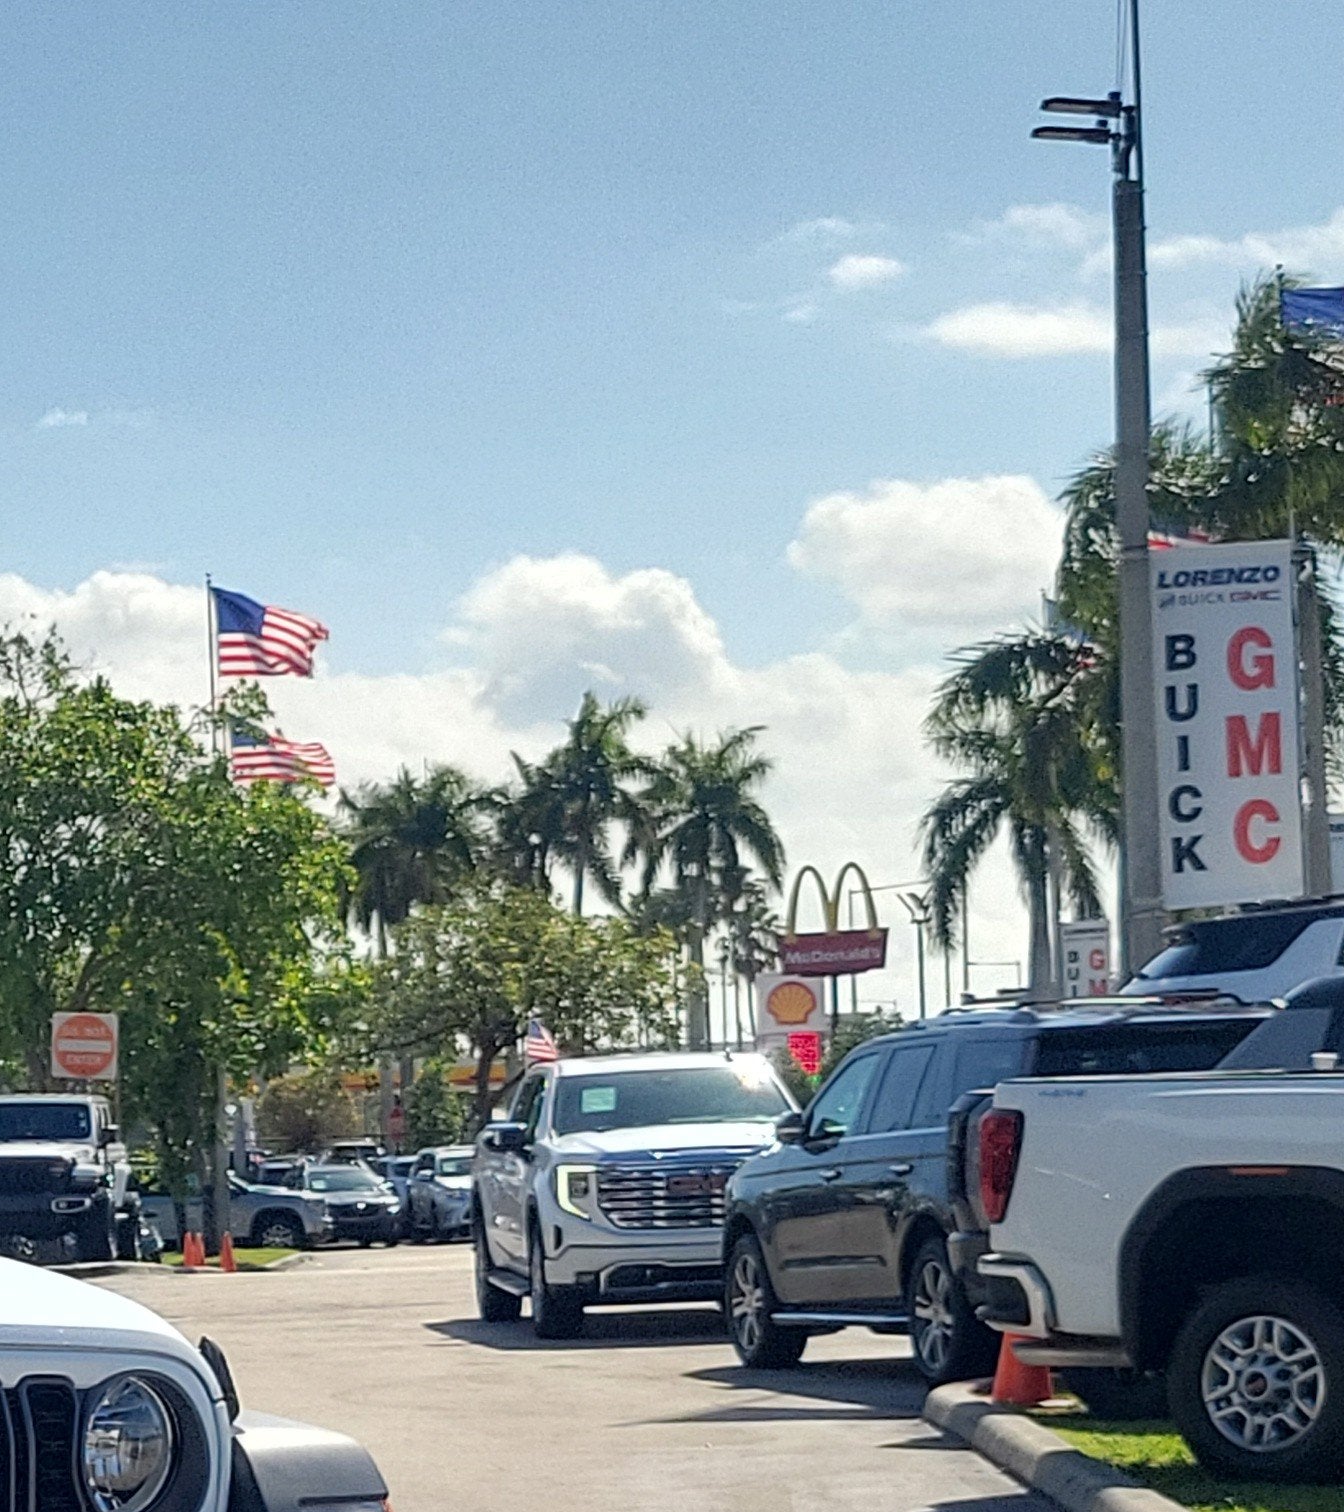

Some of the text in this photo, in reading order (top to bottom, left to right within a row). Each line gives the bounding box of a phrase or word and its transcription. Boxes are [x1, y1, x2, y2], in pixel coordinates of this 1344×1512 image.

[1157, 566, 1280, 589] LORENZO
[1164, 634, 1208, 874] BUICK
[1225, 626, 1283, 864] GMC
